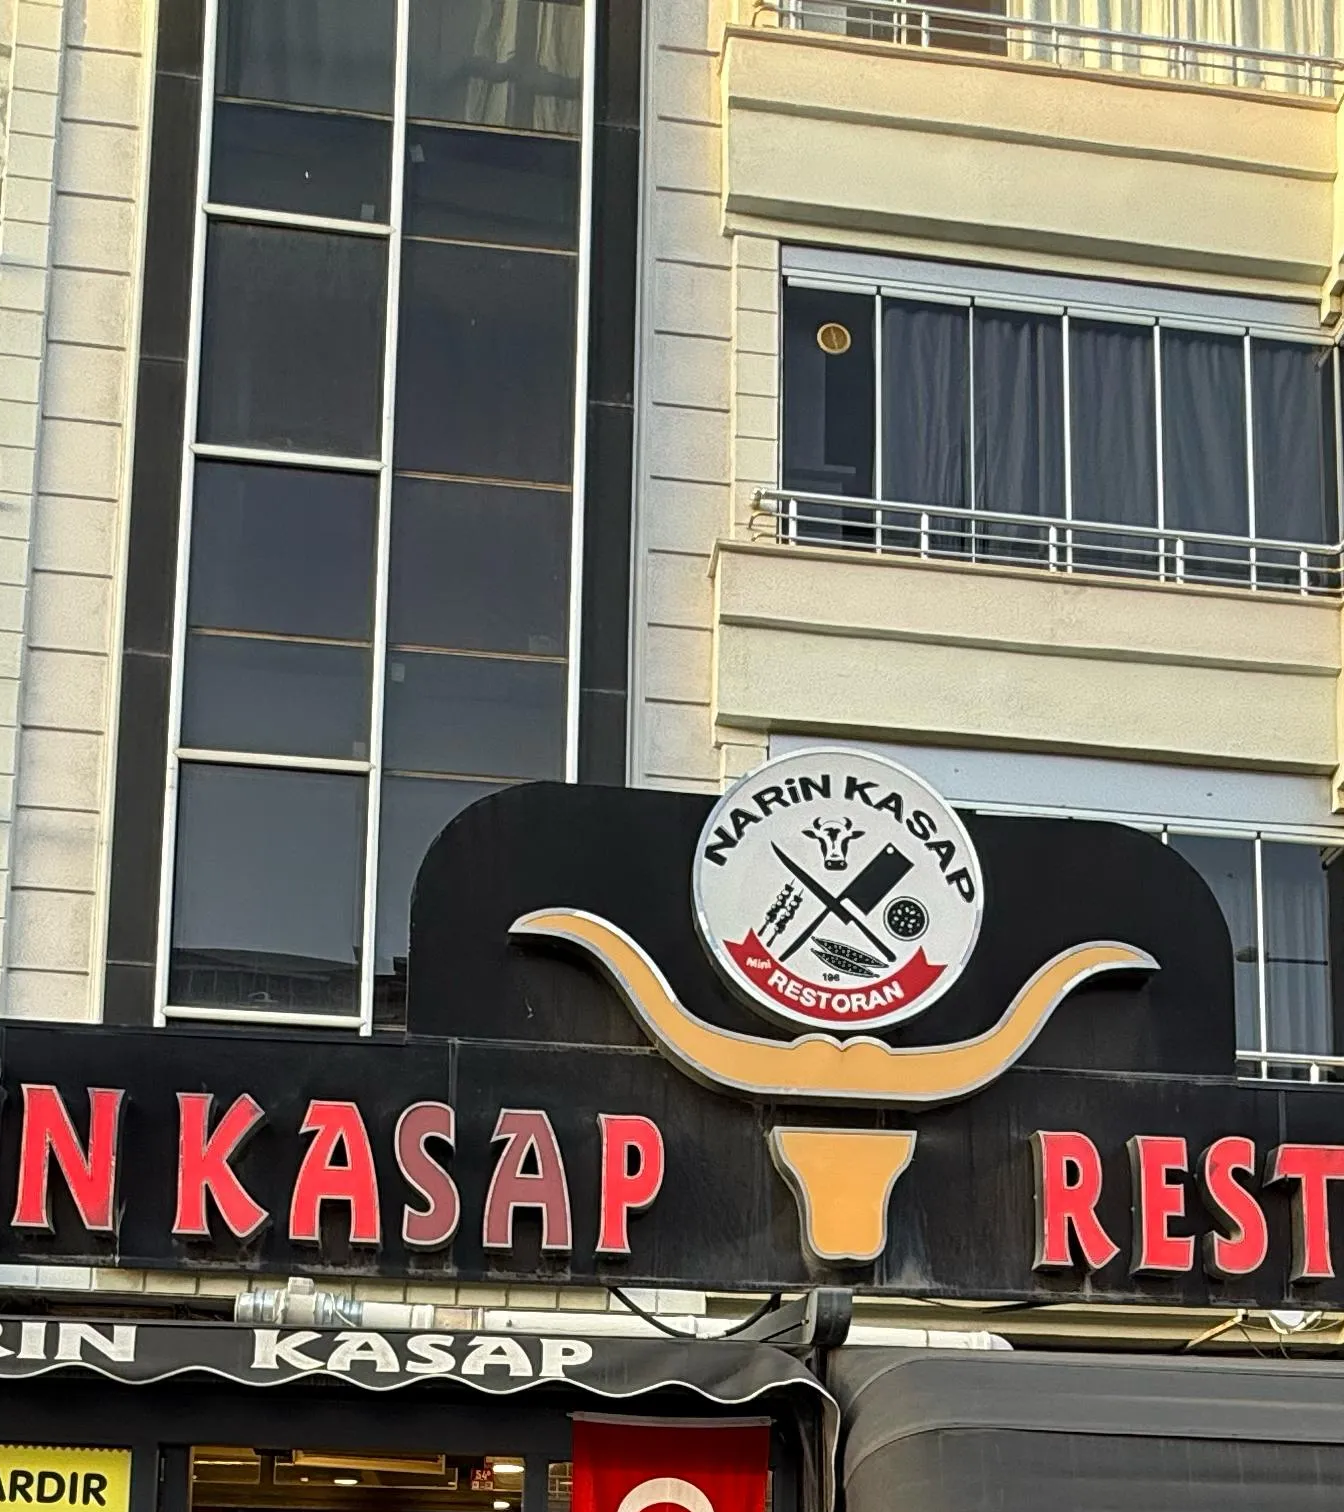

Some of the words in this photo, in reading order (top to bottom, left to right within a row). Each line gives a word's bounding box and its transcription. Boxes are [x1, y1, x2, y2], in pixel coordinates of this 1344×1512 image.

[844, 774, 975, 904] KASAP
[767, 972, 905, 1013] RESTORAN
[171, 1091, 666, 1256] KASAP
[251, 1327, 596, 1380] KASAP
